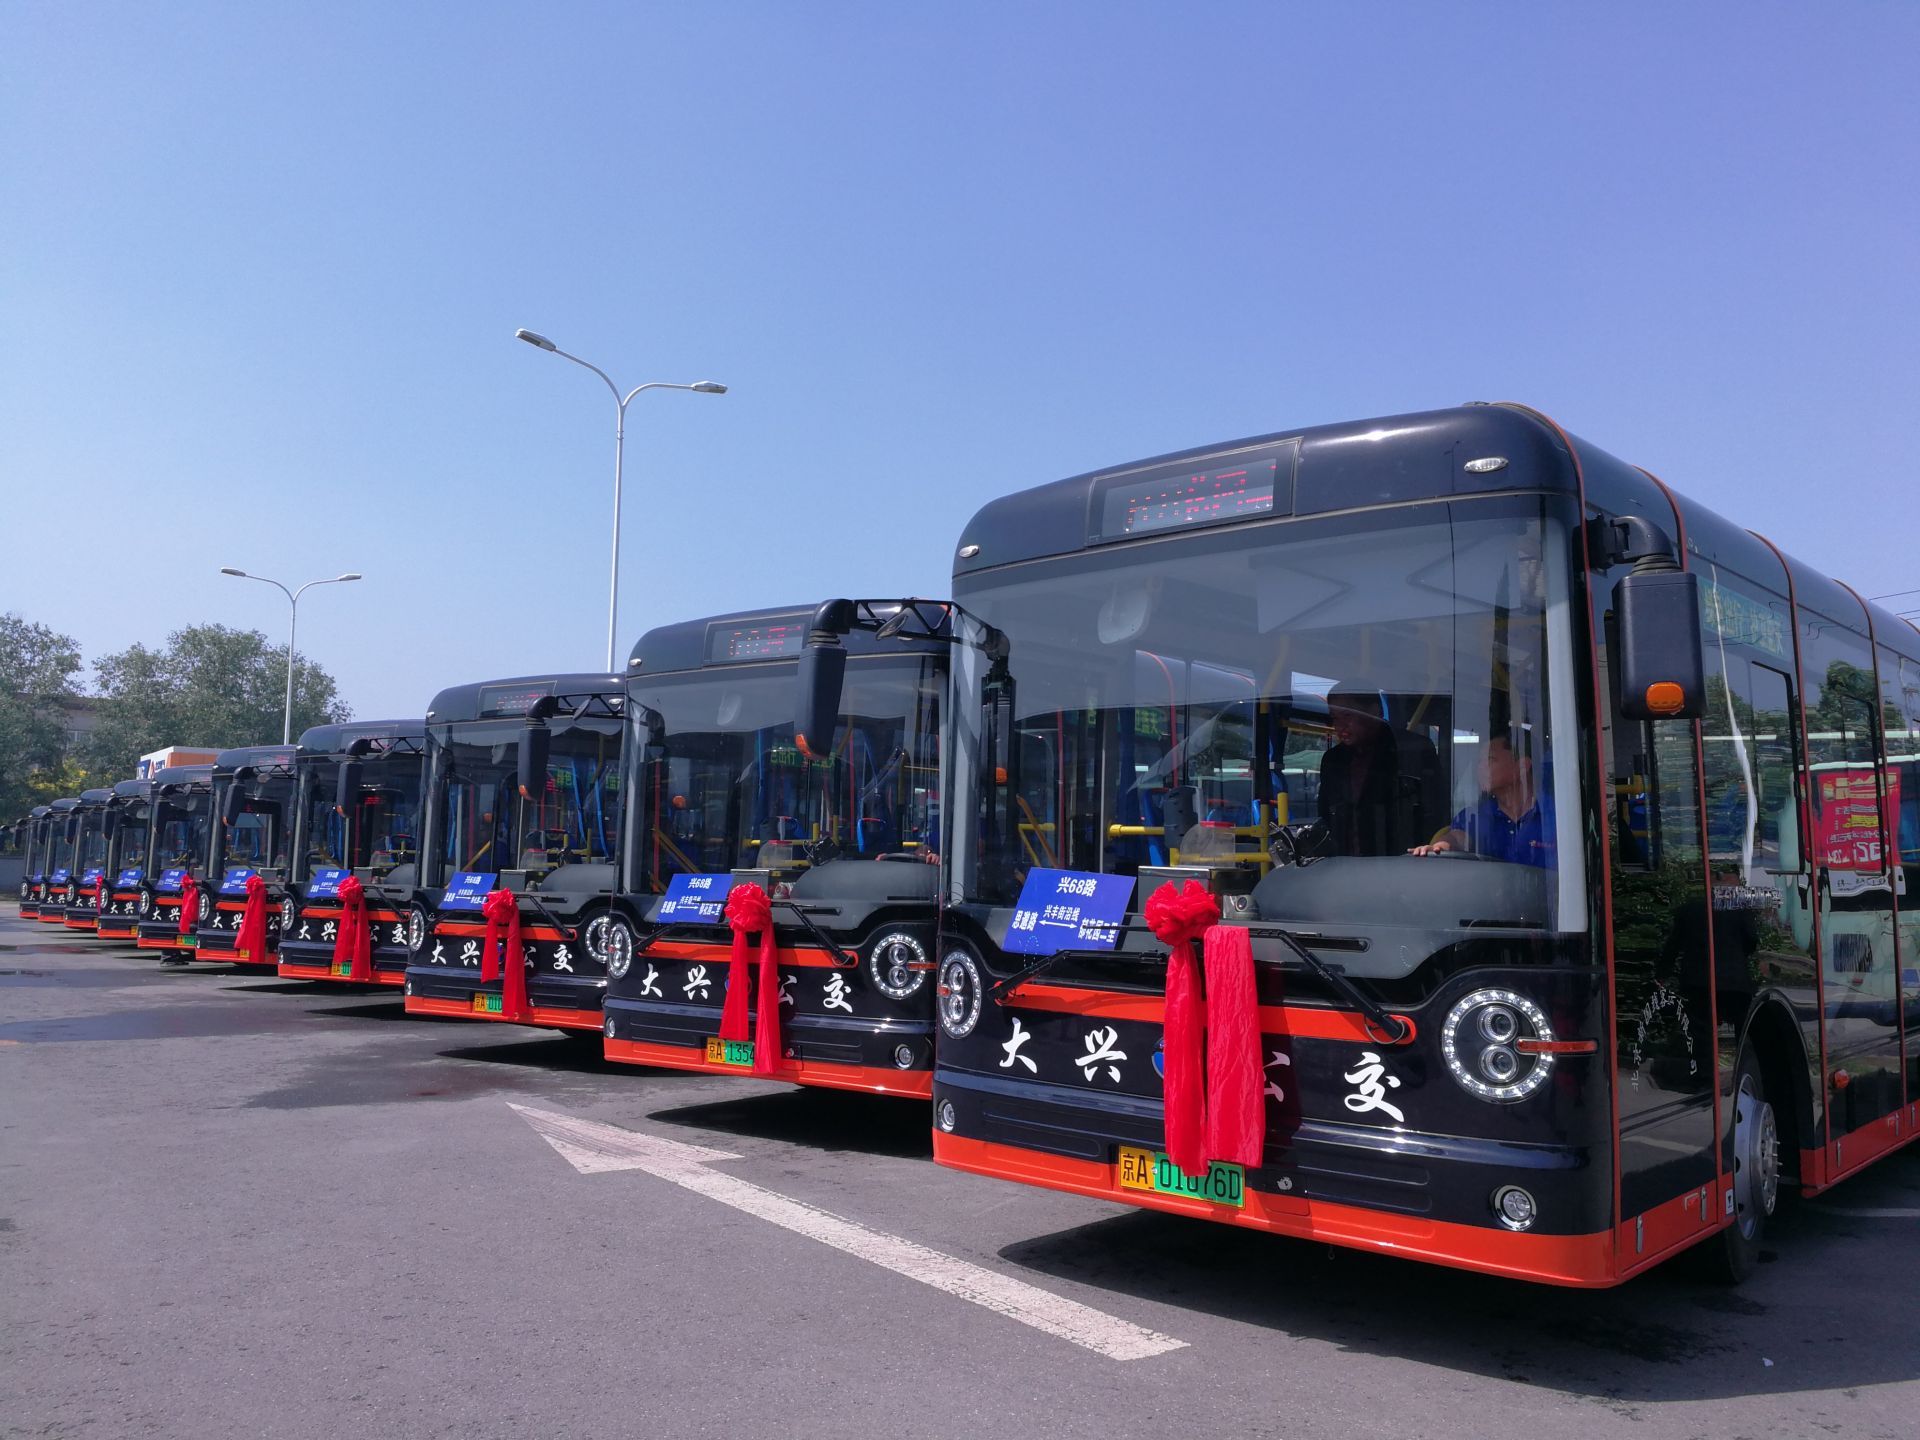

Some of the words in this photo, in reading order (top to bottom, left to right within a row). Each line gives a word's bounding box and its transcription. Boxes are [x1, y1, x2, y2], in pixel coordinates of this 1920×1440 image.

[1056, 876, 1098, 897] 兴68路
[1042, 904, 1081, 923] 兴丰街沿线
[298, 920, 337, 942] 大兴
[431, 938, 480, 967] 大兴
[640, 962, 712, 1000] 大兴
[999, 1017, 1128, 1084] 大兴
